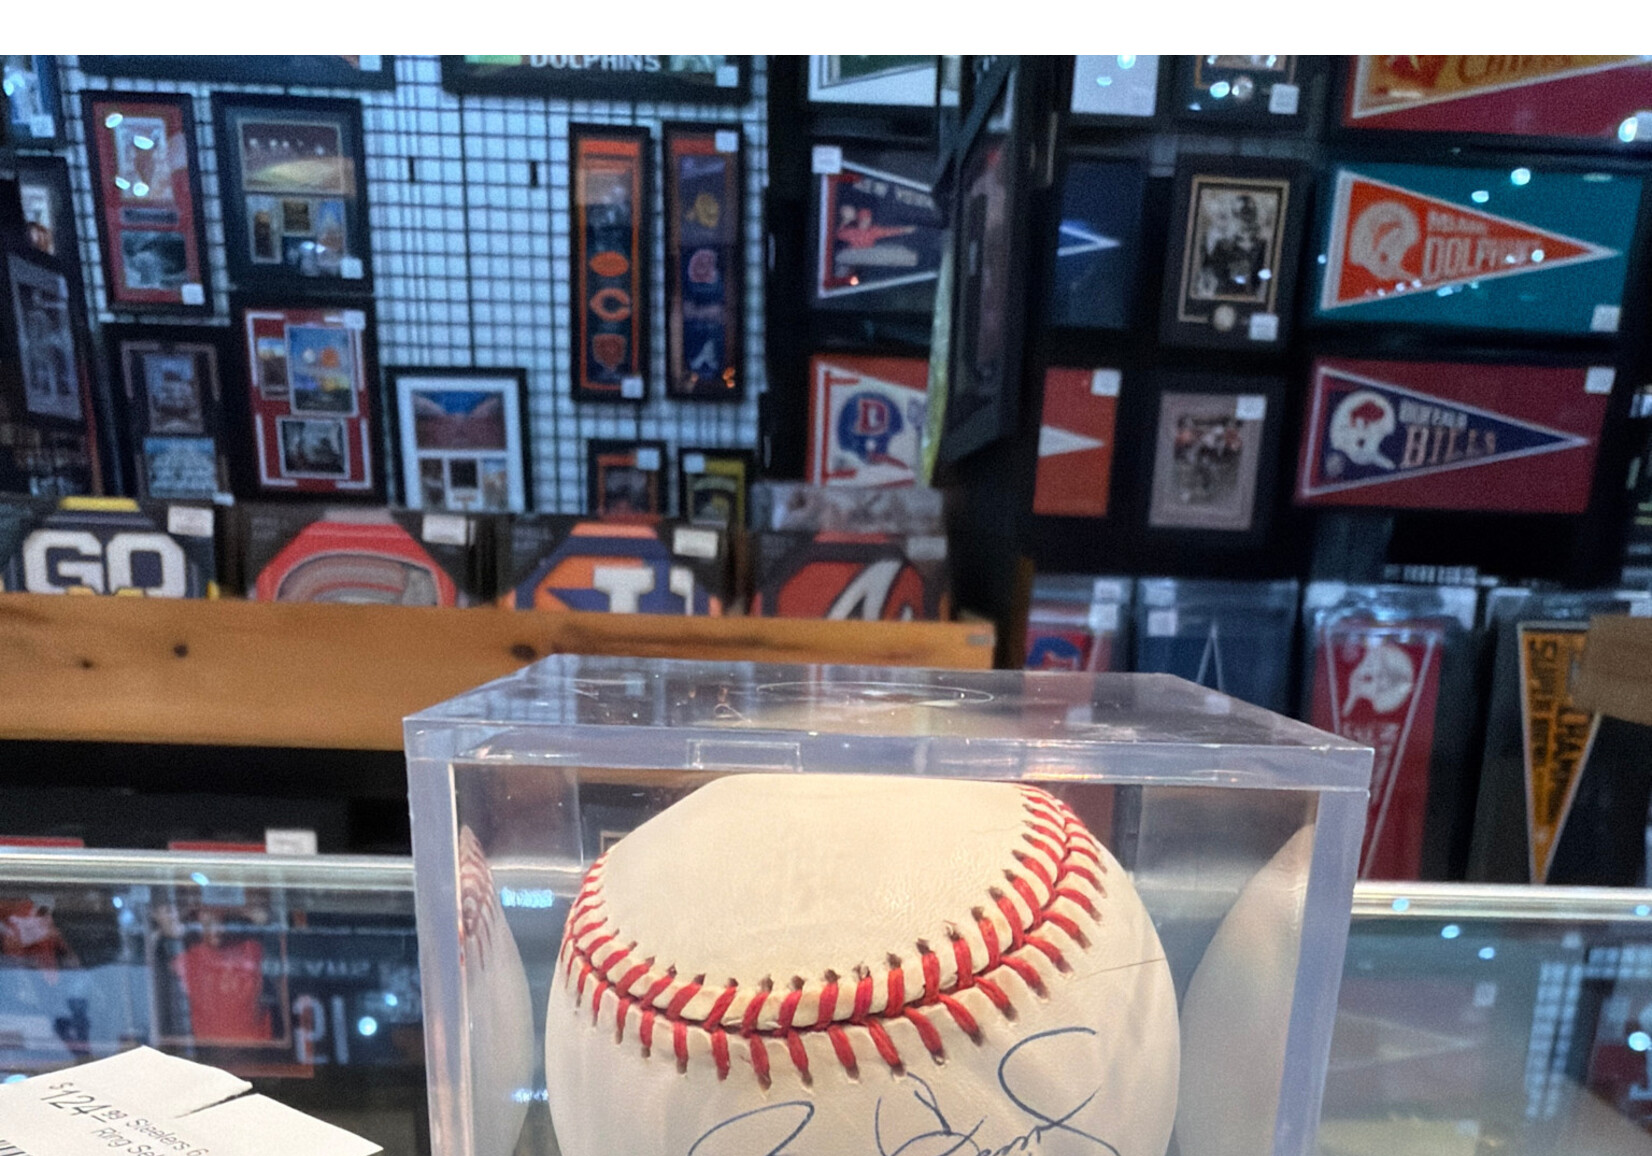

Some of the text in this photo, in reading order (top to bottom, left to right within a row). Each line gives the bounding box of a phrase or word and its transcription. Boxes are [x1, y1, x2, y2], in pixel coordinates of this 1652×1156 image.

[1400, 424, 1497, 470] BILLS
[23, 529, 187, 598] GO
[91, 1127, 132, 1148] Ring
[126, 1118, 191, 1151] Steelers
